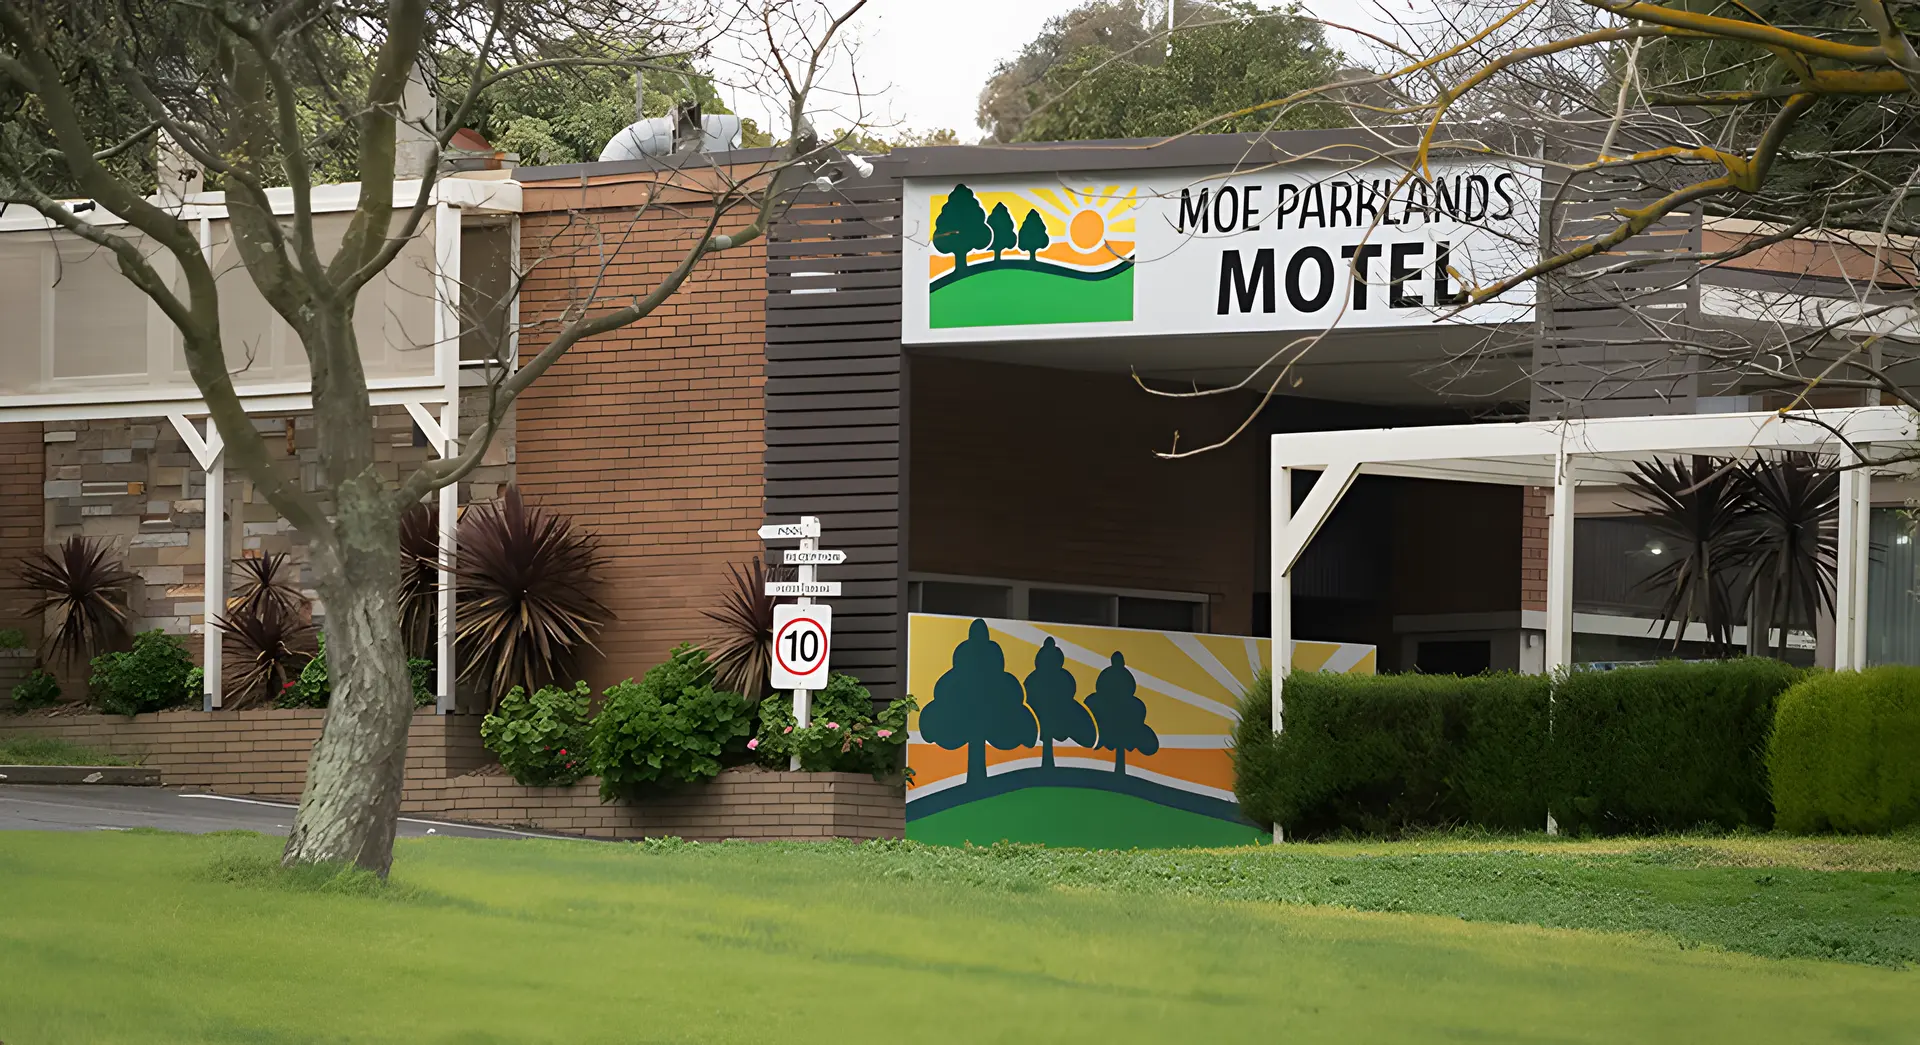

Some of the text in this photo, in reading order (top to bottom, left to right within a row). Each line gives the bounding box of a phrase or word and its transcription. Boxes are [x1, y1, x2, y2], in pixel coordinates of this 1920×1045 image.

[1178, 173, 1514, 234] MOE PARKLANDS
[1217, 241, 1469, 315] MOTEL
[785, 630, 818, 662] 10
